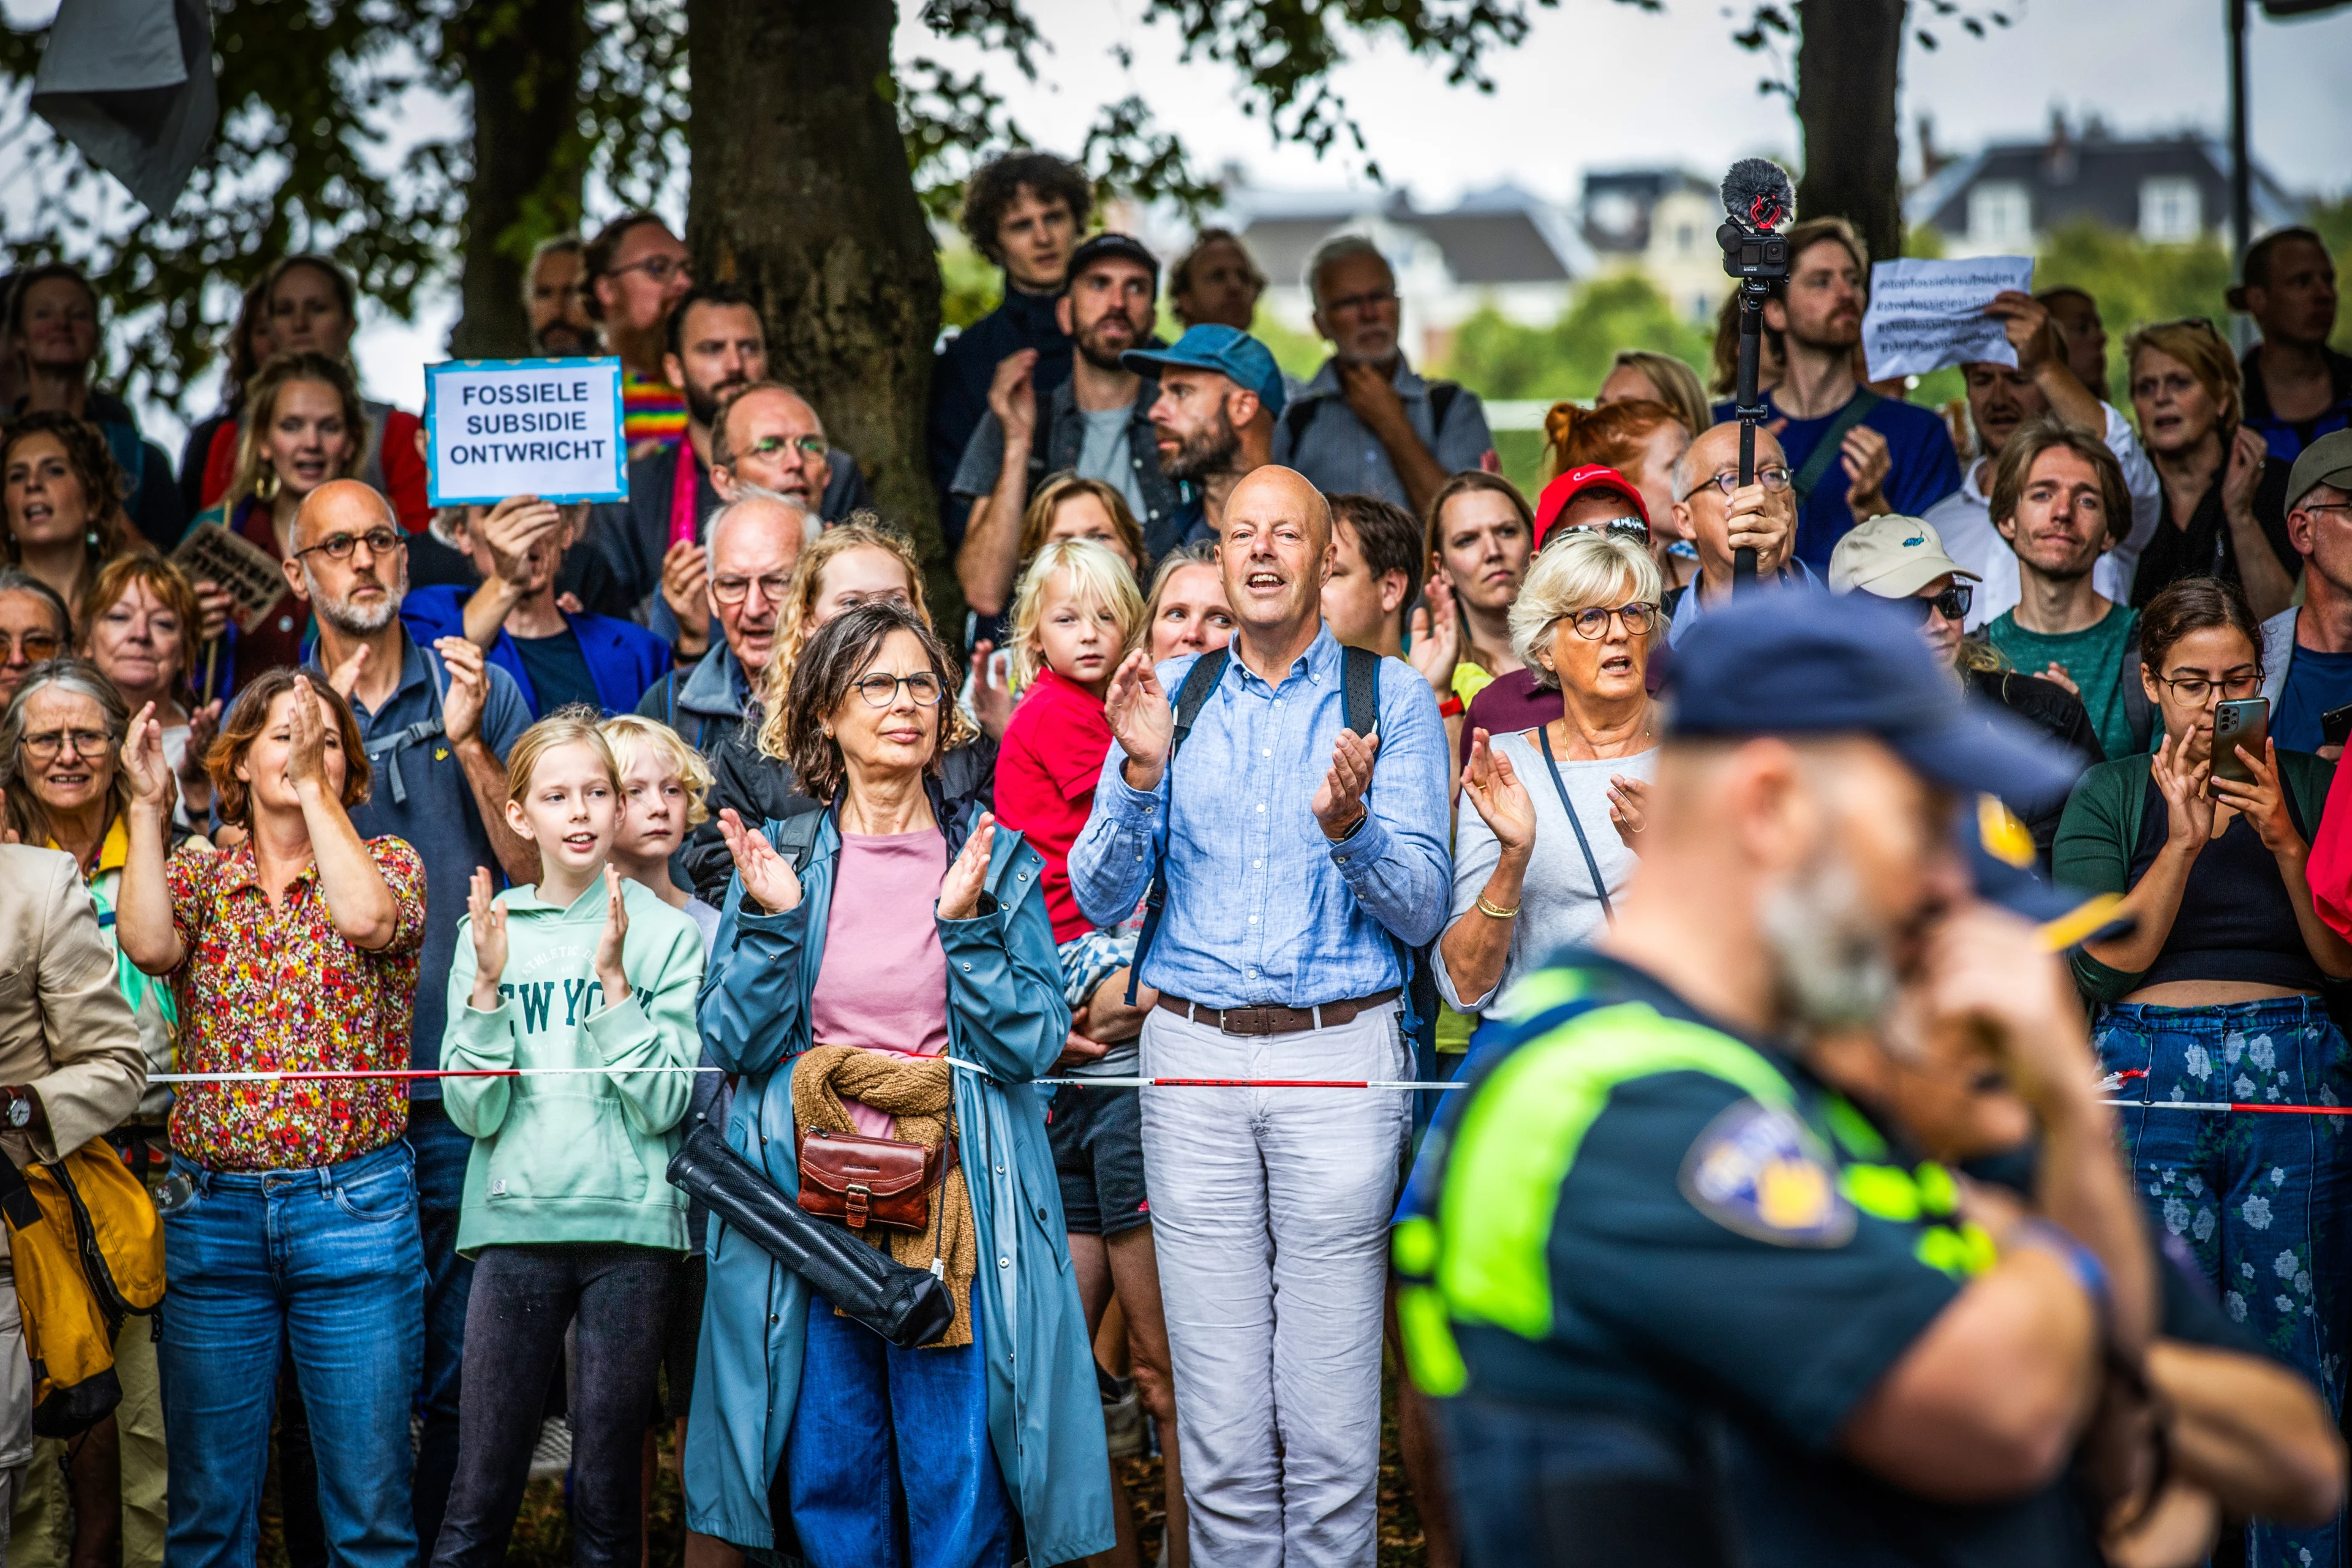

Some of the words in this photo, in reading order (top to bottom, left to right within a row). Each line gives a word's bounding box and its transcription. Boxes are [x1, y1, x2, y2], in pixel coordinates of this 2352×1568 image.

[462, 382, 589, 406] FOSSIELE
[467, 411, 587, 435] SUBSIDIE
[450, 439, 606, 465] ONTWRICHT
[521, 945, 579, 978] ATHLETIC
[564, 978, 654, 1032] YO
